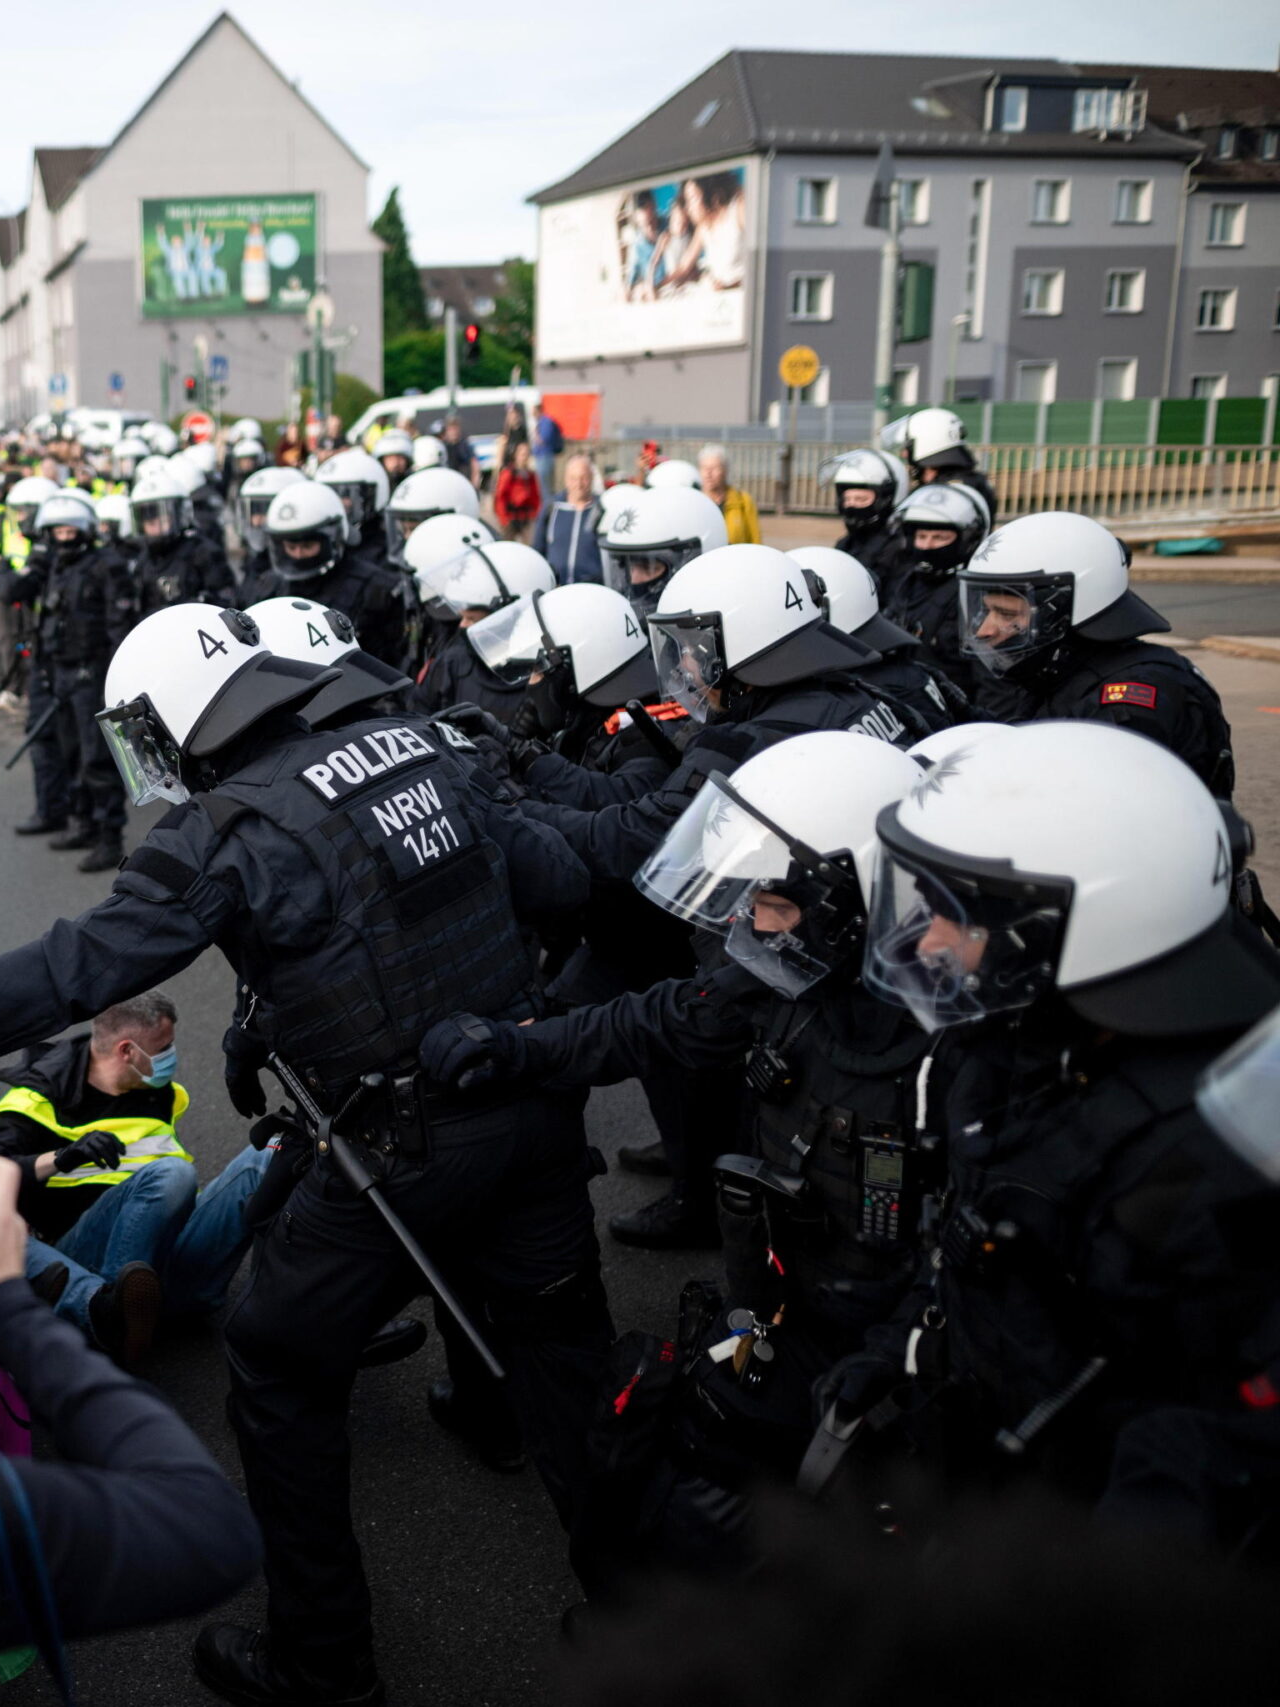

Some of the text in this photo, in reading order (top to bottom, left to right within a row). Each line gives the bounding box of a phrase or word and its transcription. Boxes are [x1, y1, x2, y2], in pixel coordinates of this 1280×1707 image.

[784, 581, 803, 612] 4
[306, 621, 330, 648] 4
[624, 613, 639, 639] 4
[197, 628, 229, 660] 4
[302, 726, 436, 800] POLIZEI
[370, 778, 443, 838] NRW
[402, 815, 461, 867] 1411
